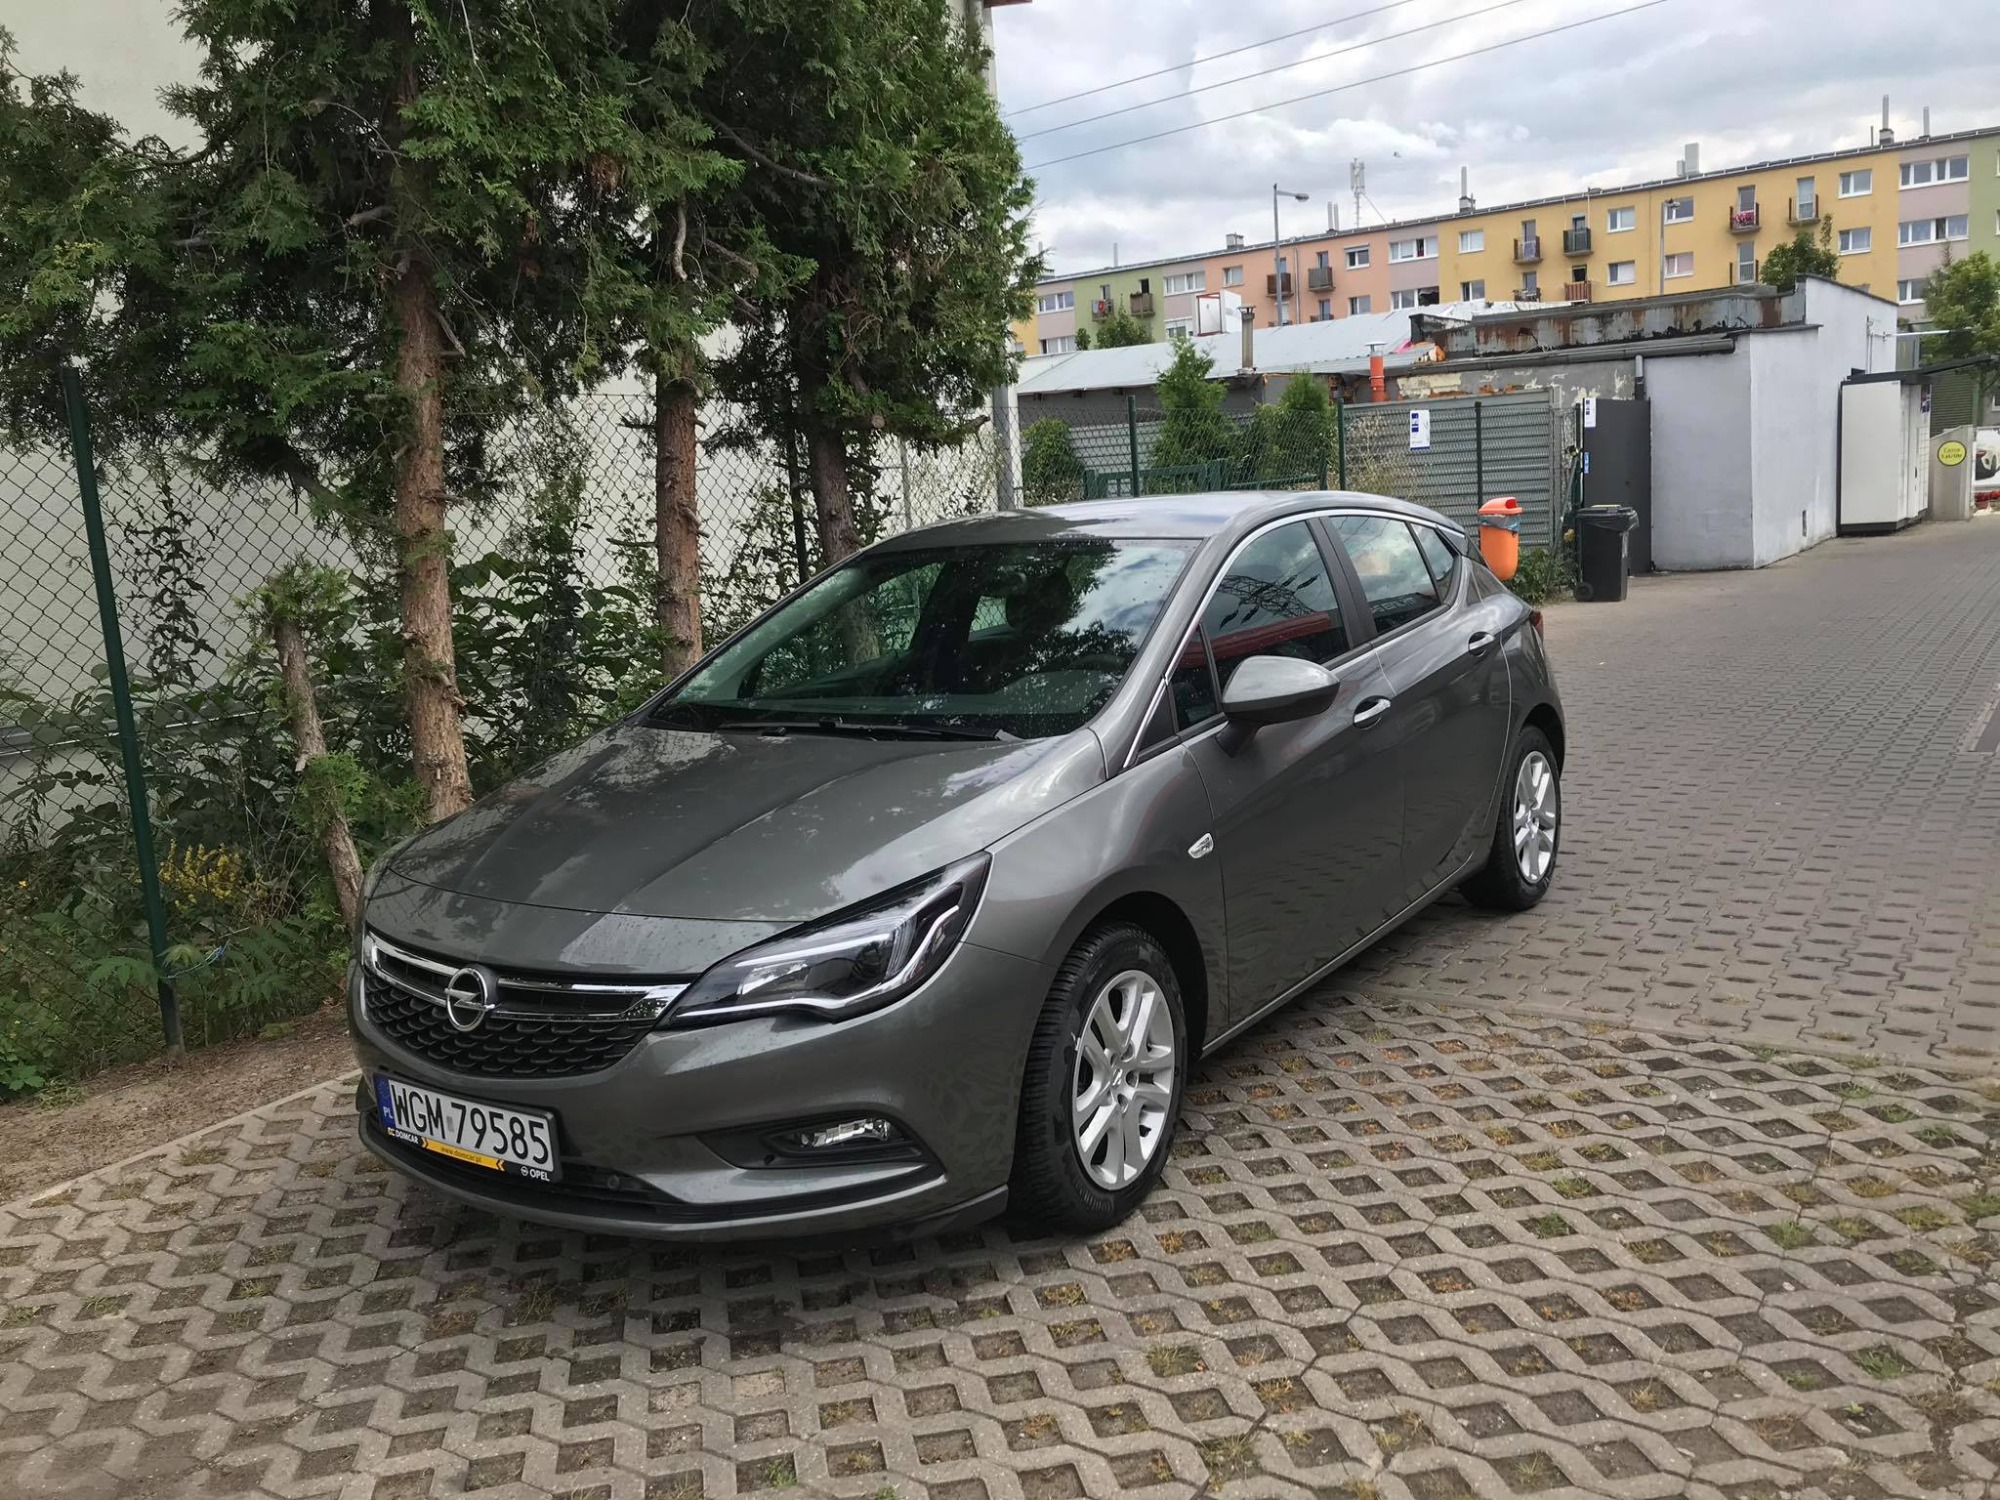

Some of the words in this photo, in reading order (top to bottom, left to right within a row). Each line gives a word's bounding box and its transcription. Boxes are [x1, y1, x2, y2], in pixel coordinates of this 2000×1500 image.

[383, 1106, 394, 1119] PL
[391, 1085, 446, 1140] WGM
[451, 1102, 549, 1165] 79585
[395, 1129, 419, 1145] DOMCAR
[529, 1168, 550, 1182] OPEL
